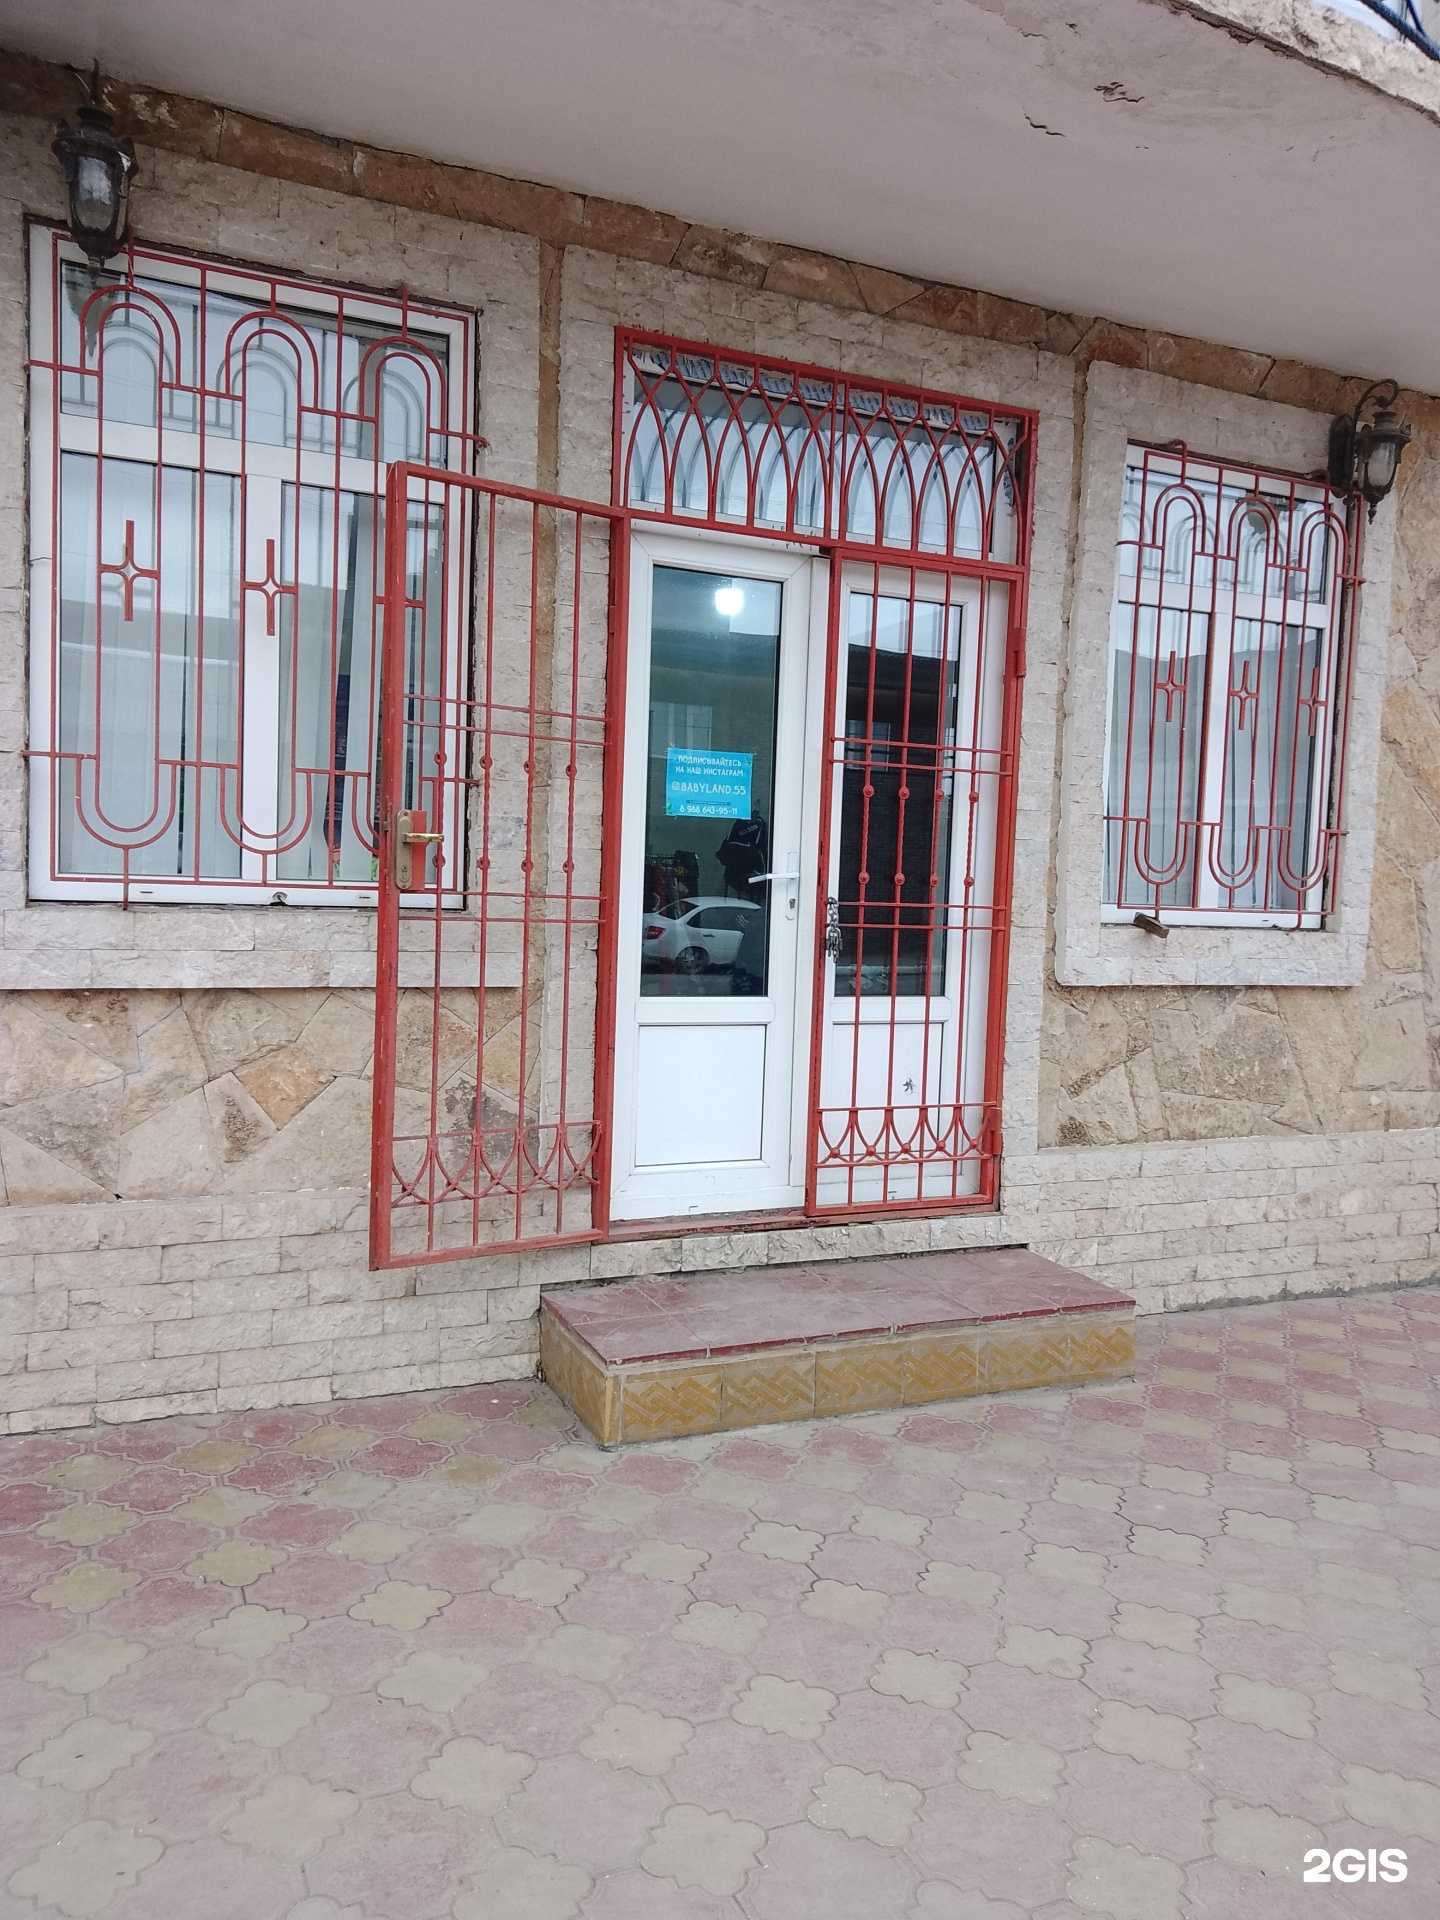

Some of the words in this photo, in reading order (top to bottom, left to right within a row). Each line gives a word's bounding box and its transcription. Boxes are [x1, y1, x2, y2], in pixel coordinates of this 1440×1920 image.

[678, 755, 742, 767] ПОДПИСЫВАЙТЕСЬ
[687, 767, 702, 775] НАШ
[704, 768, 744, 777] ИНСТАГРАМ
